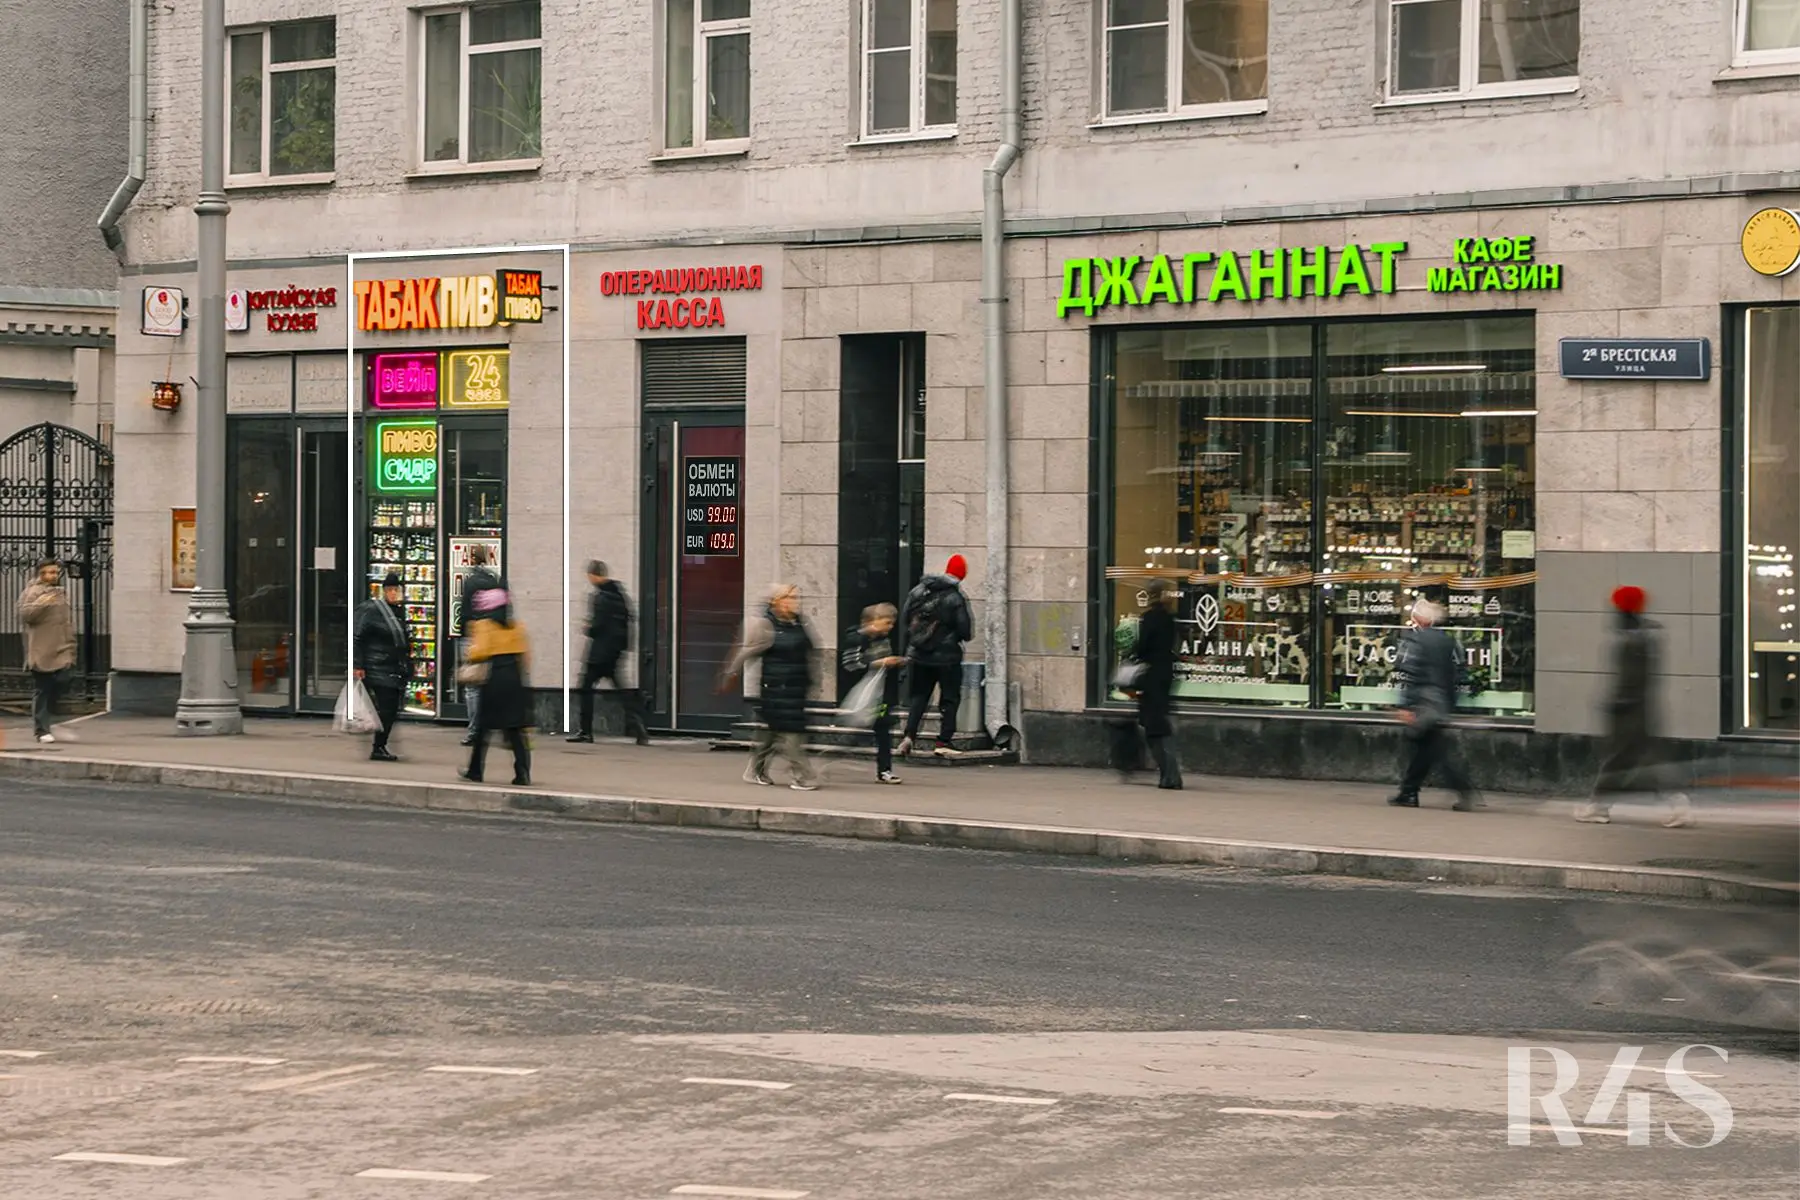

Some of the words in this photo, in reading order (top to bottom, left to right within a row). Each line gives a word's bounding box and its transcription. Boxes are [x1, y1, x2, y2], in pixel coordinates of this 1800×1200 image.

[1452, 235, 1532, 263] КАФЕ
[505, 273, 541, 296] ТАБАК
[600, 265, 763, 296] ОПЕРАЦИОННАЯ
[1056, 241, 1403, 319] ДЖАГАННАТ
[1426, 264, 1560, 292] МАГАЗИН
[248, 284, 337, 309] КИТАЙСКАЯ
[353, 277, 440, 330] ТАБАК
[440, 275, 511, 328] ПИВ
[505, 297, 542, 321] ПИВО
[637, 297, 726, 329] КАССА
[267, 312, 317, 332] КУХНЯ
[1601, 349, 1677, 362] БРЕСТСКАЯ
[381, 361, 437, 394] ВЕЙП
[465, 355, 501, 389] 24
[383, 430, 437, 453] ПИВО
[384, 458, 437, 483] СИДР
[689, 463, 735, 480] ОБМЕН
[689, 483, 736, 497] ВАЛЮТЫ
[687, 508, 704, 522] USD
[707, 506, 736, 523] 99.00
[686, 535, 704, 548] EUR
[710, 533, 735, 549] 109.0
[1363, 590, 1394, 603] КОФЕ
[1224, 604, 1245, 620] 24
[1180, 640, 1267, 658] АГАННАТ
